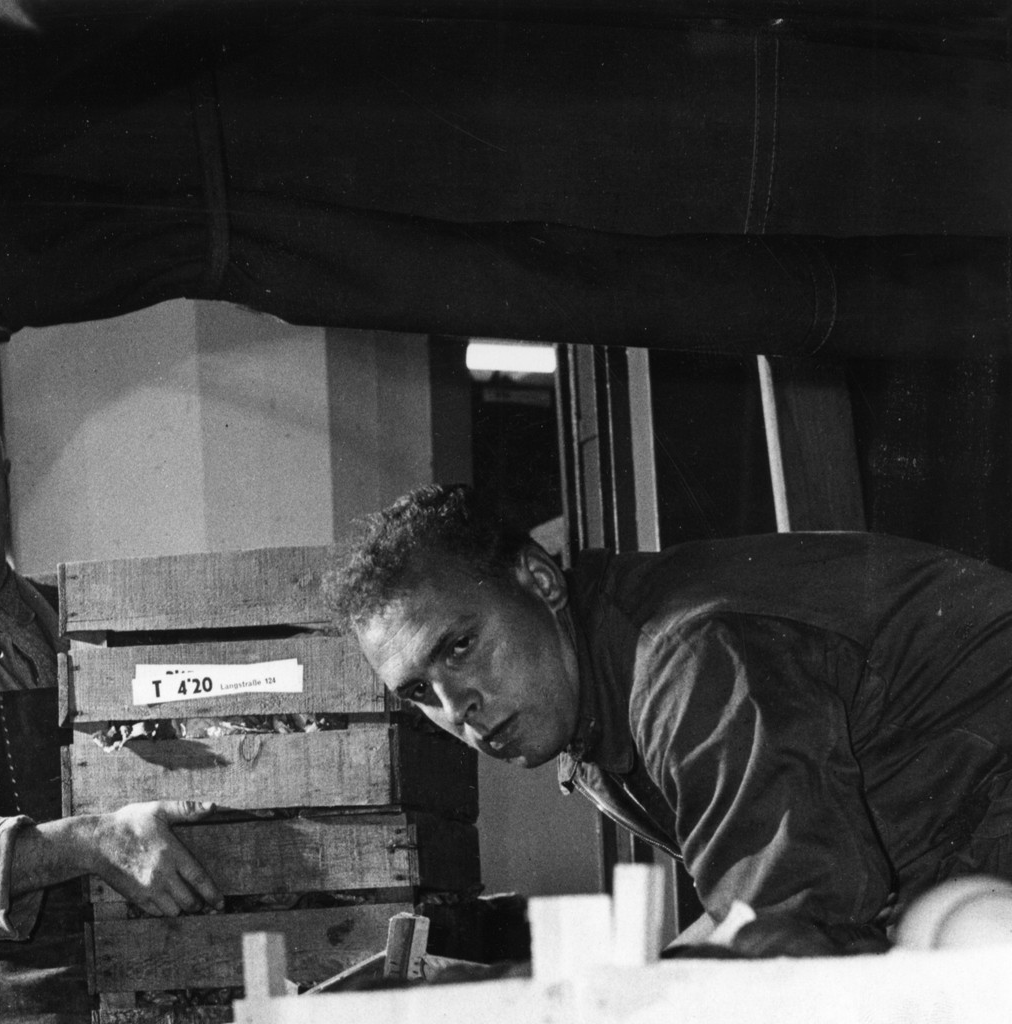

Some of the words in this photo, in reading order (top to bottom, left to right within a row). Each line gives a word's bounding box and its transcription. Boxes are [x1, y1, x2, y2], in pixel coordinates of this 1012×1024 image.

[152, 680, 162, 698] T
[220, 679, 262, 691] Langstraße
[265, 677, 276, 685] 124
